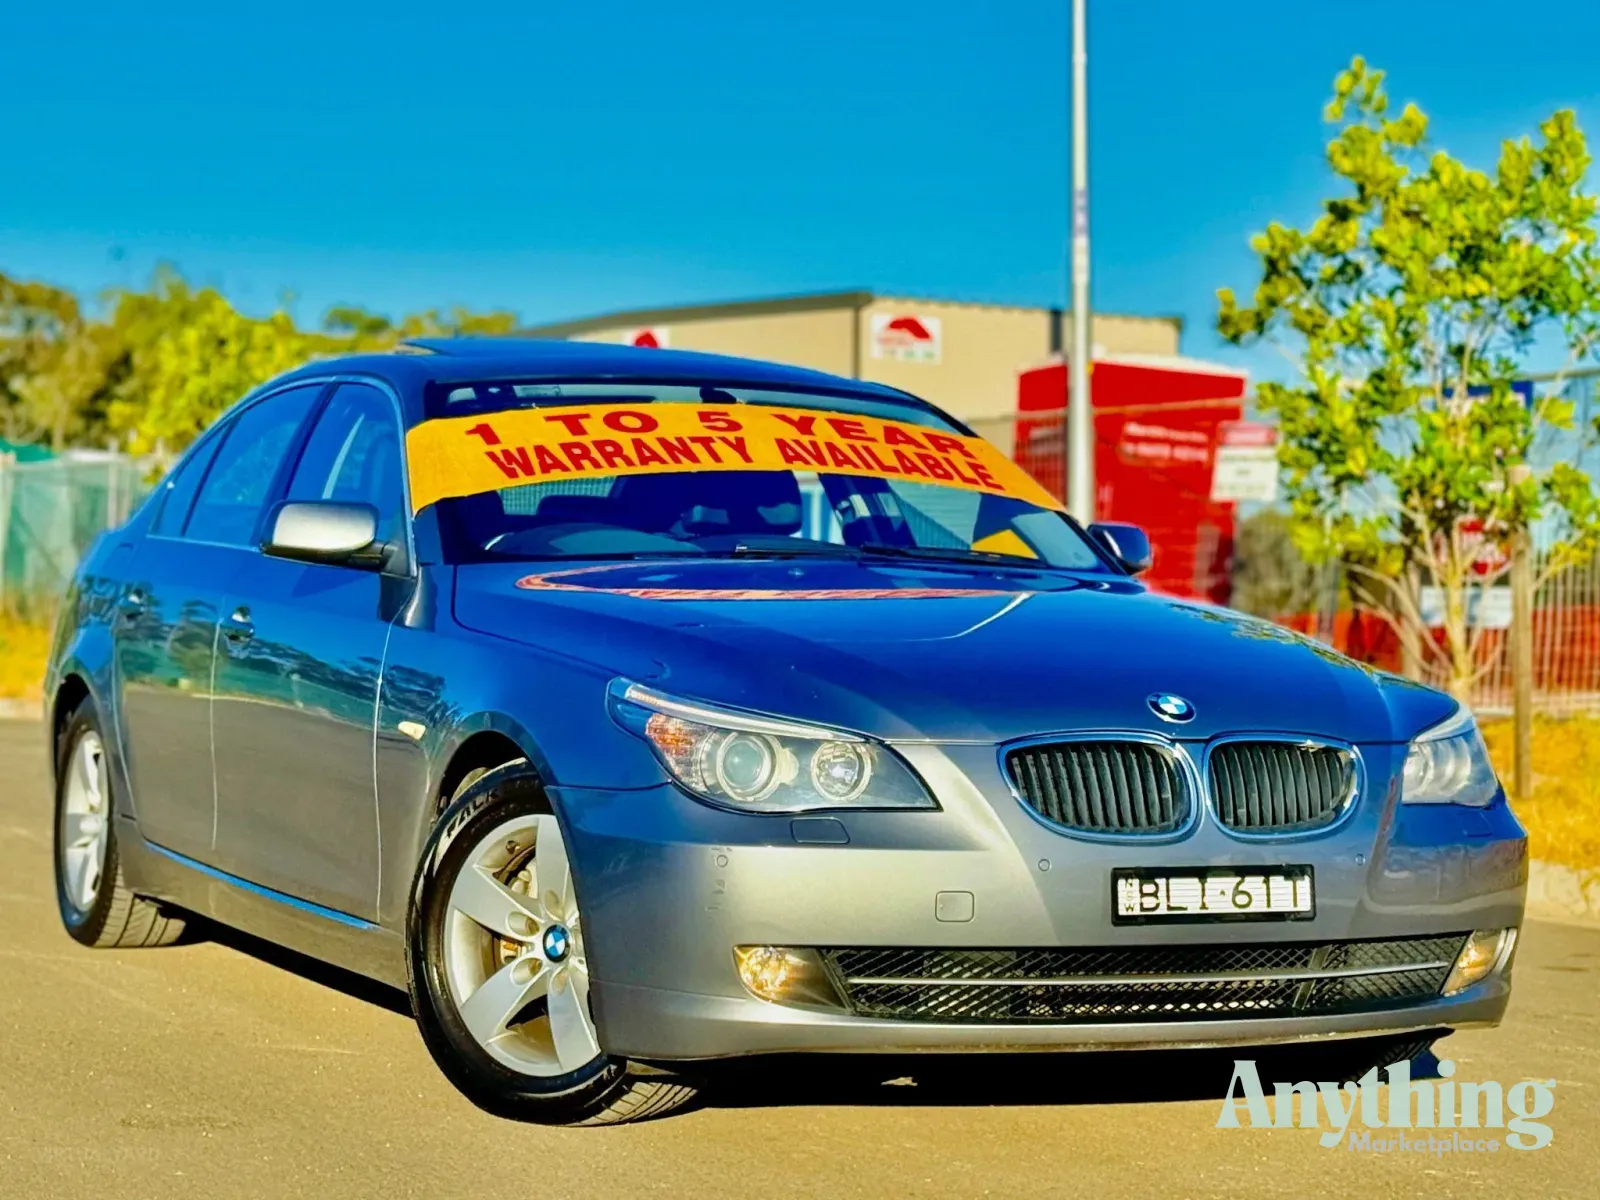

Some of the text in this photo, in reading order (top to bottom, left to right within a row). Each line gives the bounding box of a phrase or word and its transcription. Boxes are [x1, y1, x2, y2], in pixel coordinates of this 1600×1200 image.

[465, 410, 977, 460] 1 TO 5 YEAR
[484, 436, 1005, 491] WARRANTY AVAILABLE
